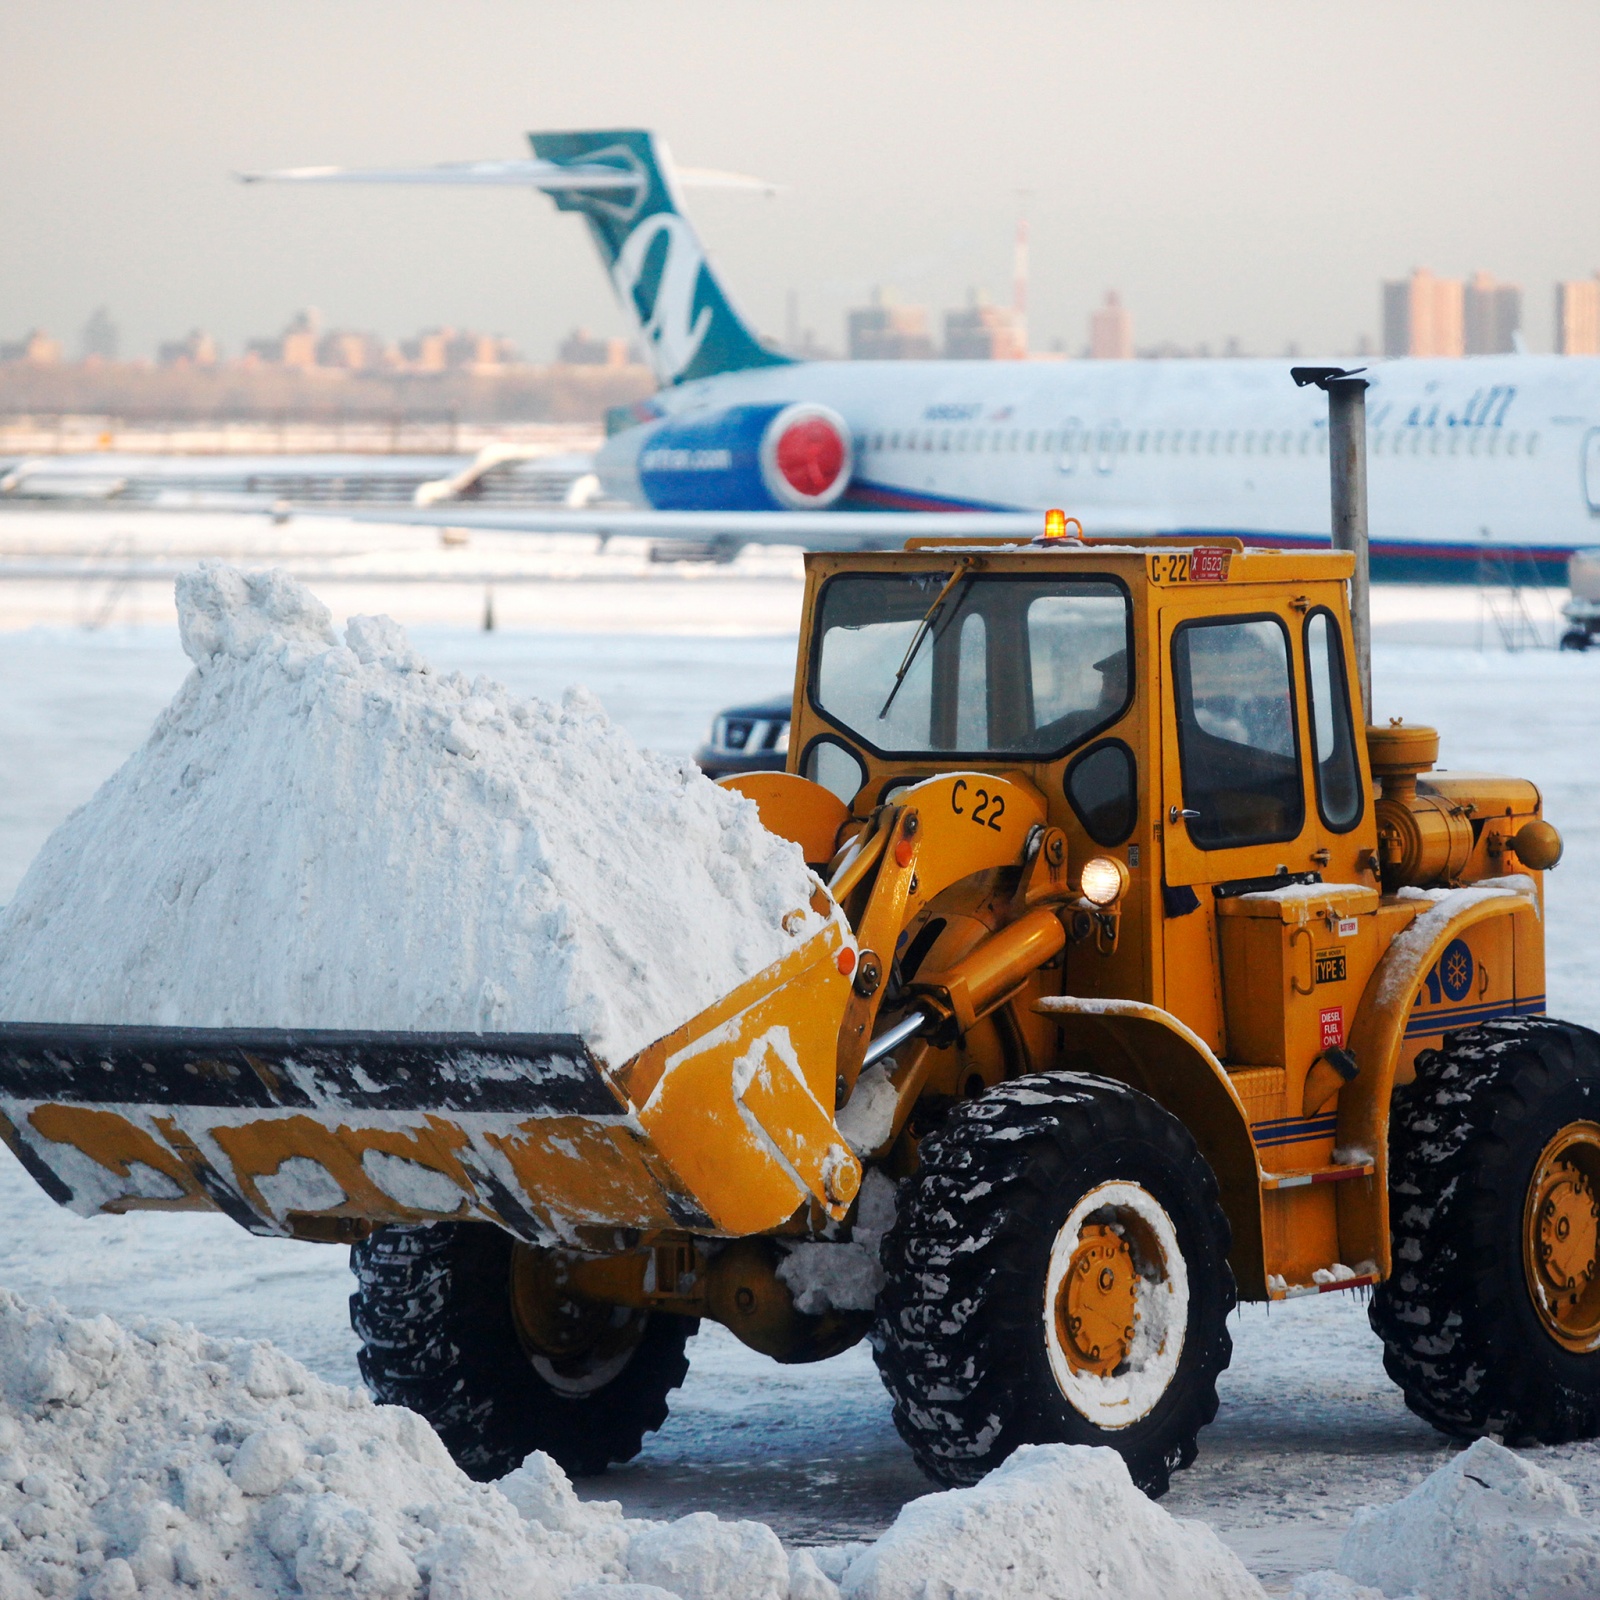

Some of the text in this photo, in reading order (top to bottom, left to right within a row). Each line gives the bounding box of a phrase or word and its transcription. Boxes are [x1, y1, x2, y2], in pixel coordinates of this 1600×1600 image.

[1192, 557, 1198, 570] X
[1202, 557, 1222, 571] 0523
[952, 779, 1005, 832] C 22
[1340, 922, 1356, 932] BATTERY
[1315, 958, 1345, 981] TYPE 3
[1321, 1011, 1341, 1023] DIESEL
[1324, 1023, 1338, 1034] FUEL
[1323, 1034, 1341, 1046] ONLY
